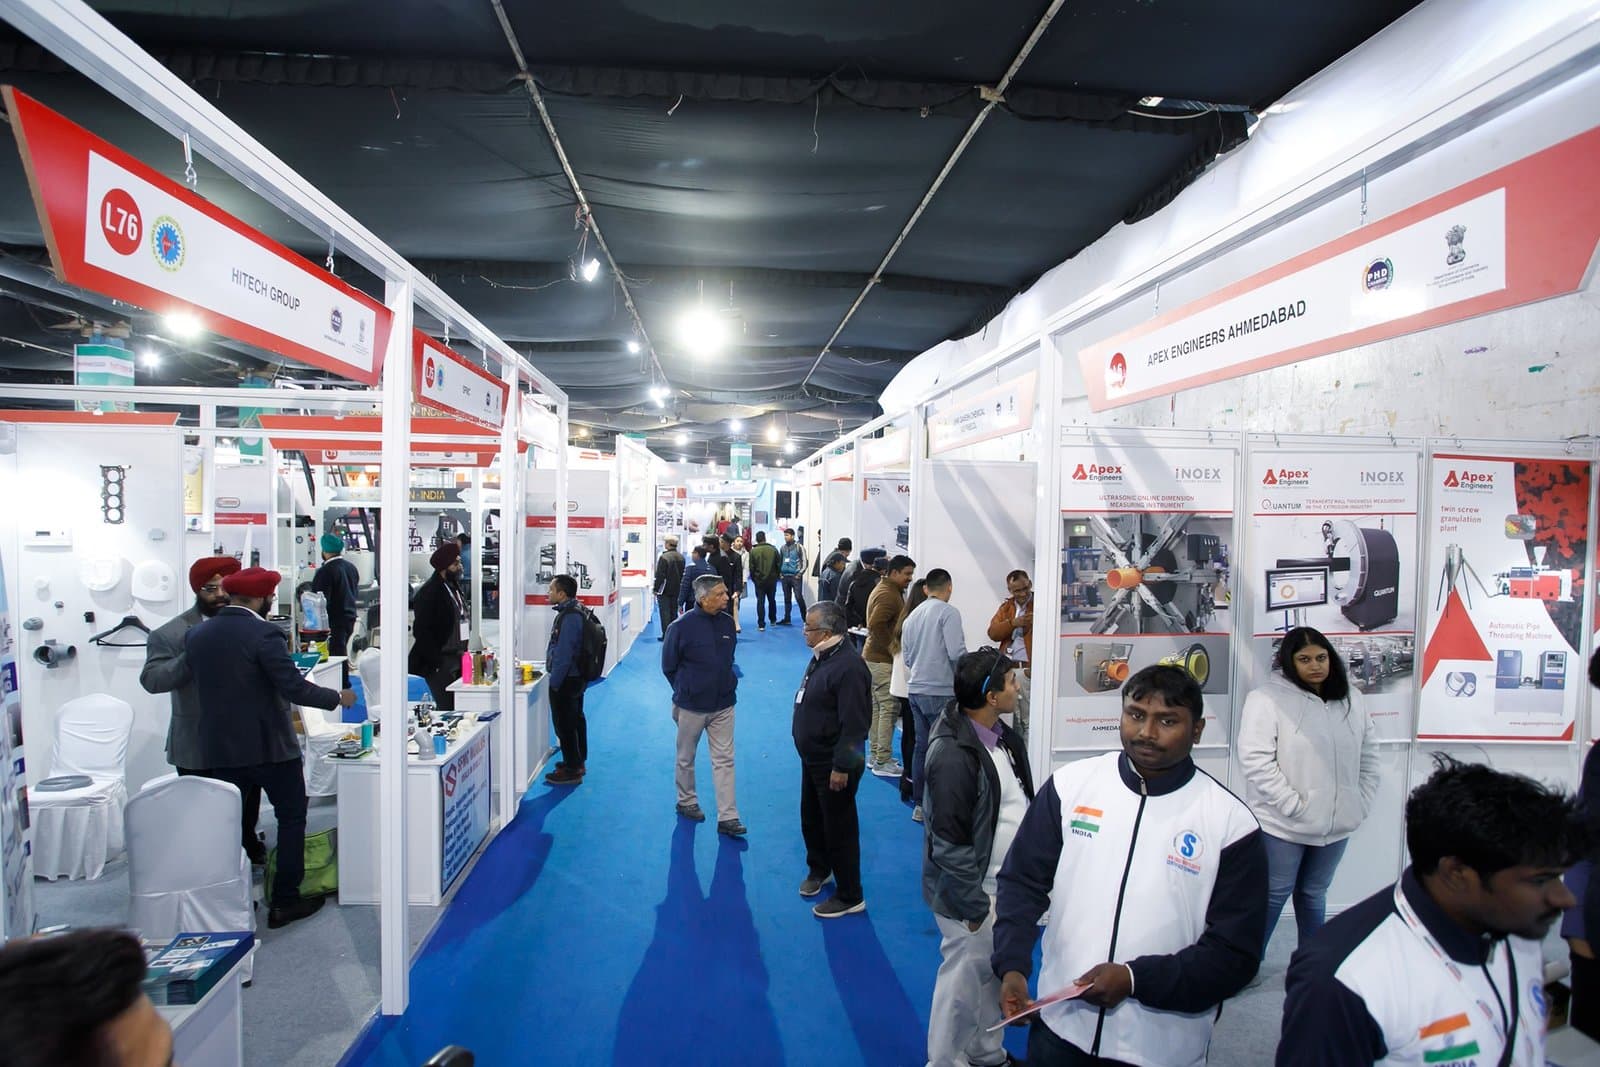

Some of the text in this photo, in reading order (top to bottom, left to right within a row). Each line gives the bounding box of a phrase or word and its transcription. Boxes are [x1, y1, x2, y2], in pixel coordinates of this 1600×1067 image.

[104, 202, 138, 241] L76
[1368, 268, 1388, 282] PHD
[231, 267, 301, 312] HITECH GROUP
[1147, 300, 1306, 367] APEX ENGINEERS AHMEDABAD
[1089, 464, 1122, 475] Apex
[1278, 468, 1309, 479] Apex
[1460, 471, 1494, 482] Apex
[420, 490, 446, 500] INDIA
[1440, 524, 1457, 532] plant
[1489, 622, 1524, 630] Automatic
[1488, 632, 1524, 640] Threading
[1072, 828, 1092, 839] INDIA
